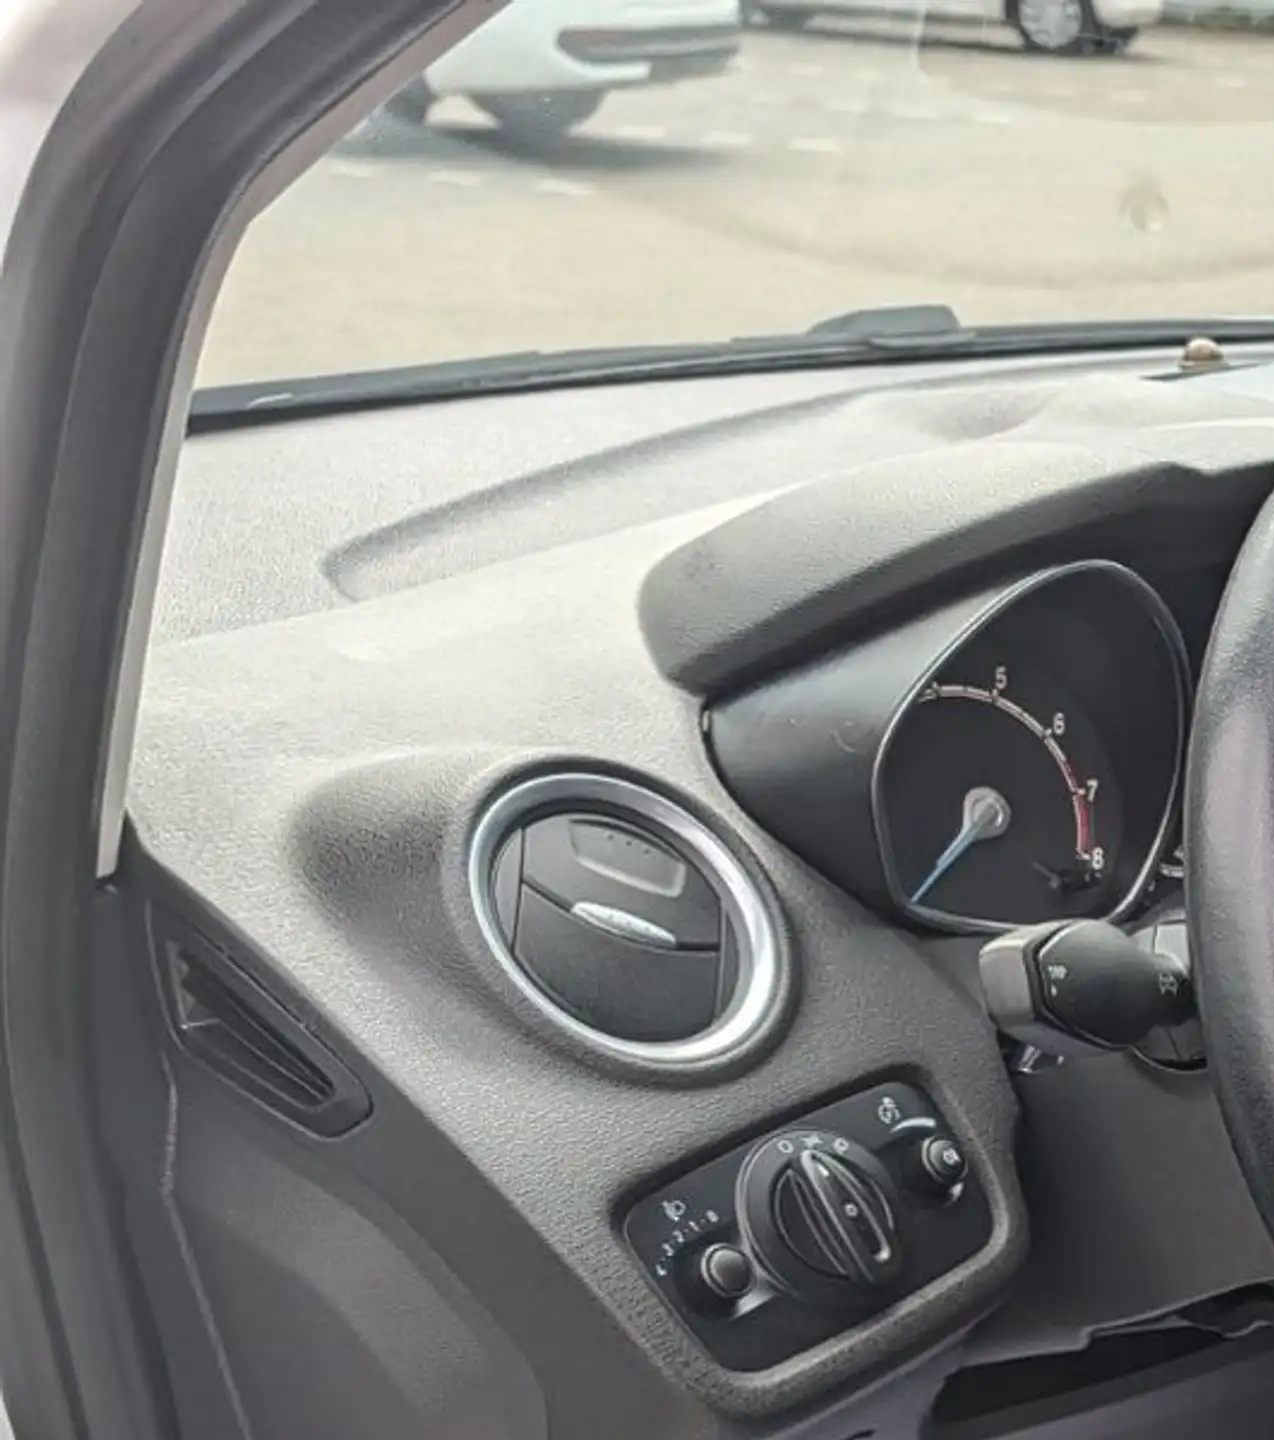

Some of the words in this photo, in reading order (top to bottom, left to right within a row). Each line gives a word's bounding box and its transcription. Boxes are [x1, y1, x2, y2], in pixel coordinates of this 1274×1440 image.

[995, 666, 1007, 689] 5
[1053, 712, 1065, 735] 6
[1086, 778, 1099, 802] 7
[1091, 847, 1105, 870] 8
